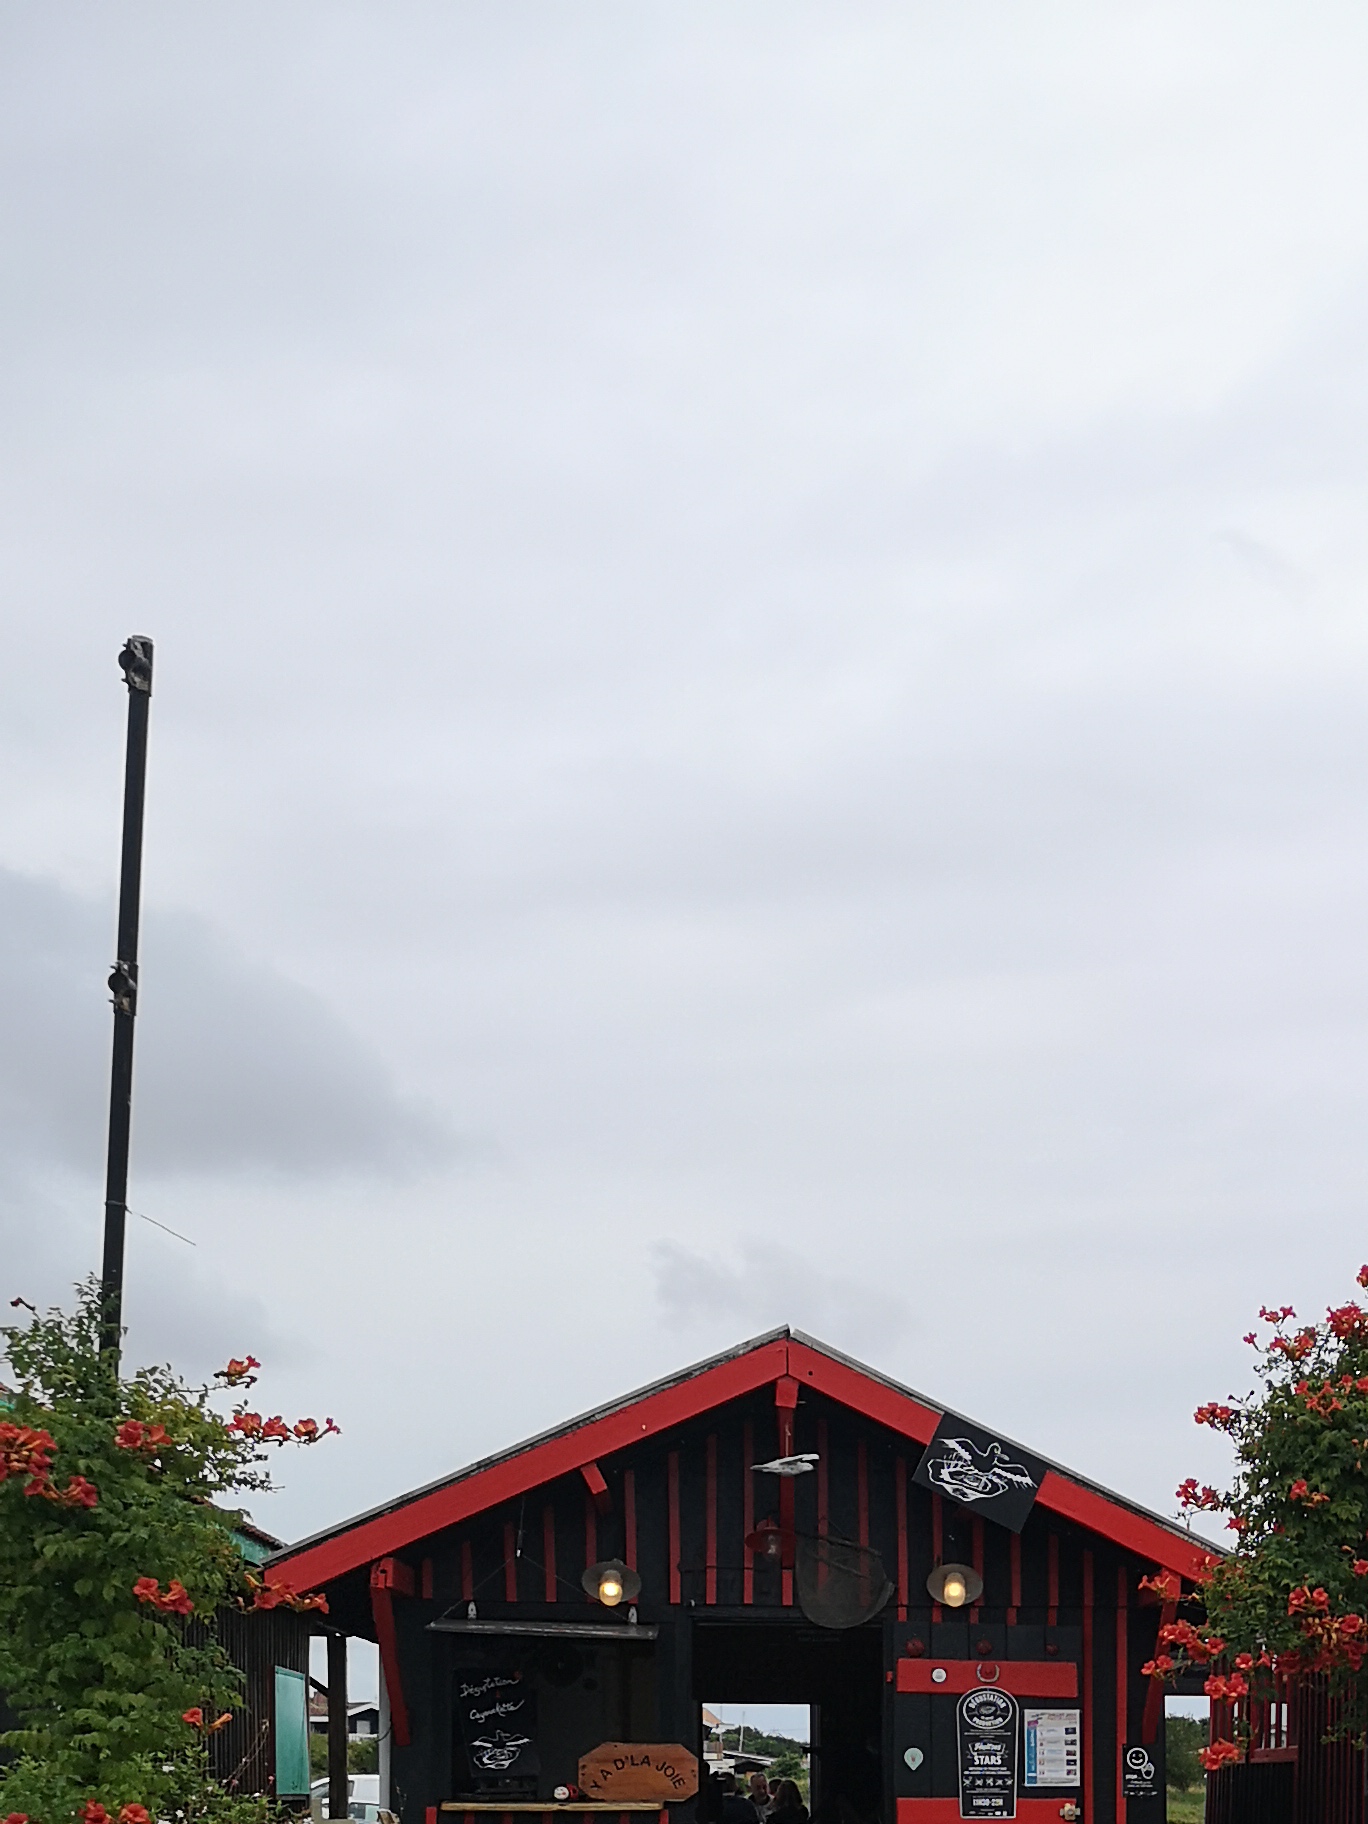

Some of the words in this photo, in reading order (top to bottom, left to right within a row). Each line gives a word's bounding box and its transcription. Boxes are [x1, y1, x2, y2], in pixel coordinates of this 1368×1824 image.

[591, 1781, 603, 1792] Y
[600, 1768, 613, 1782] A
[613, 1755, 651, 1771] D'LA
[655, 1760, 686, 1790] JOIE
